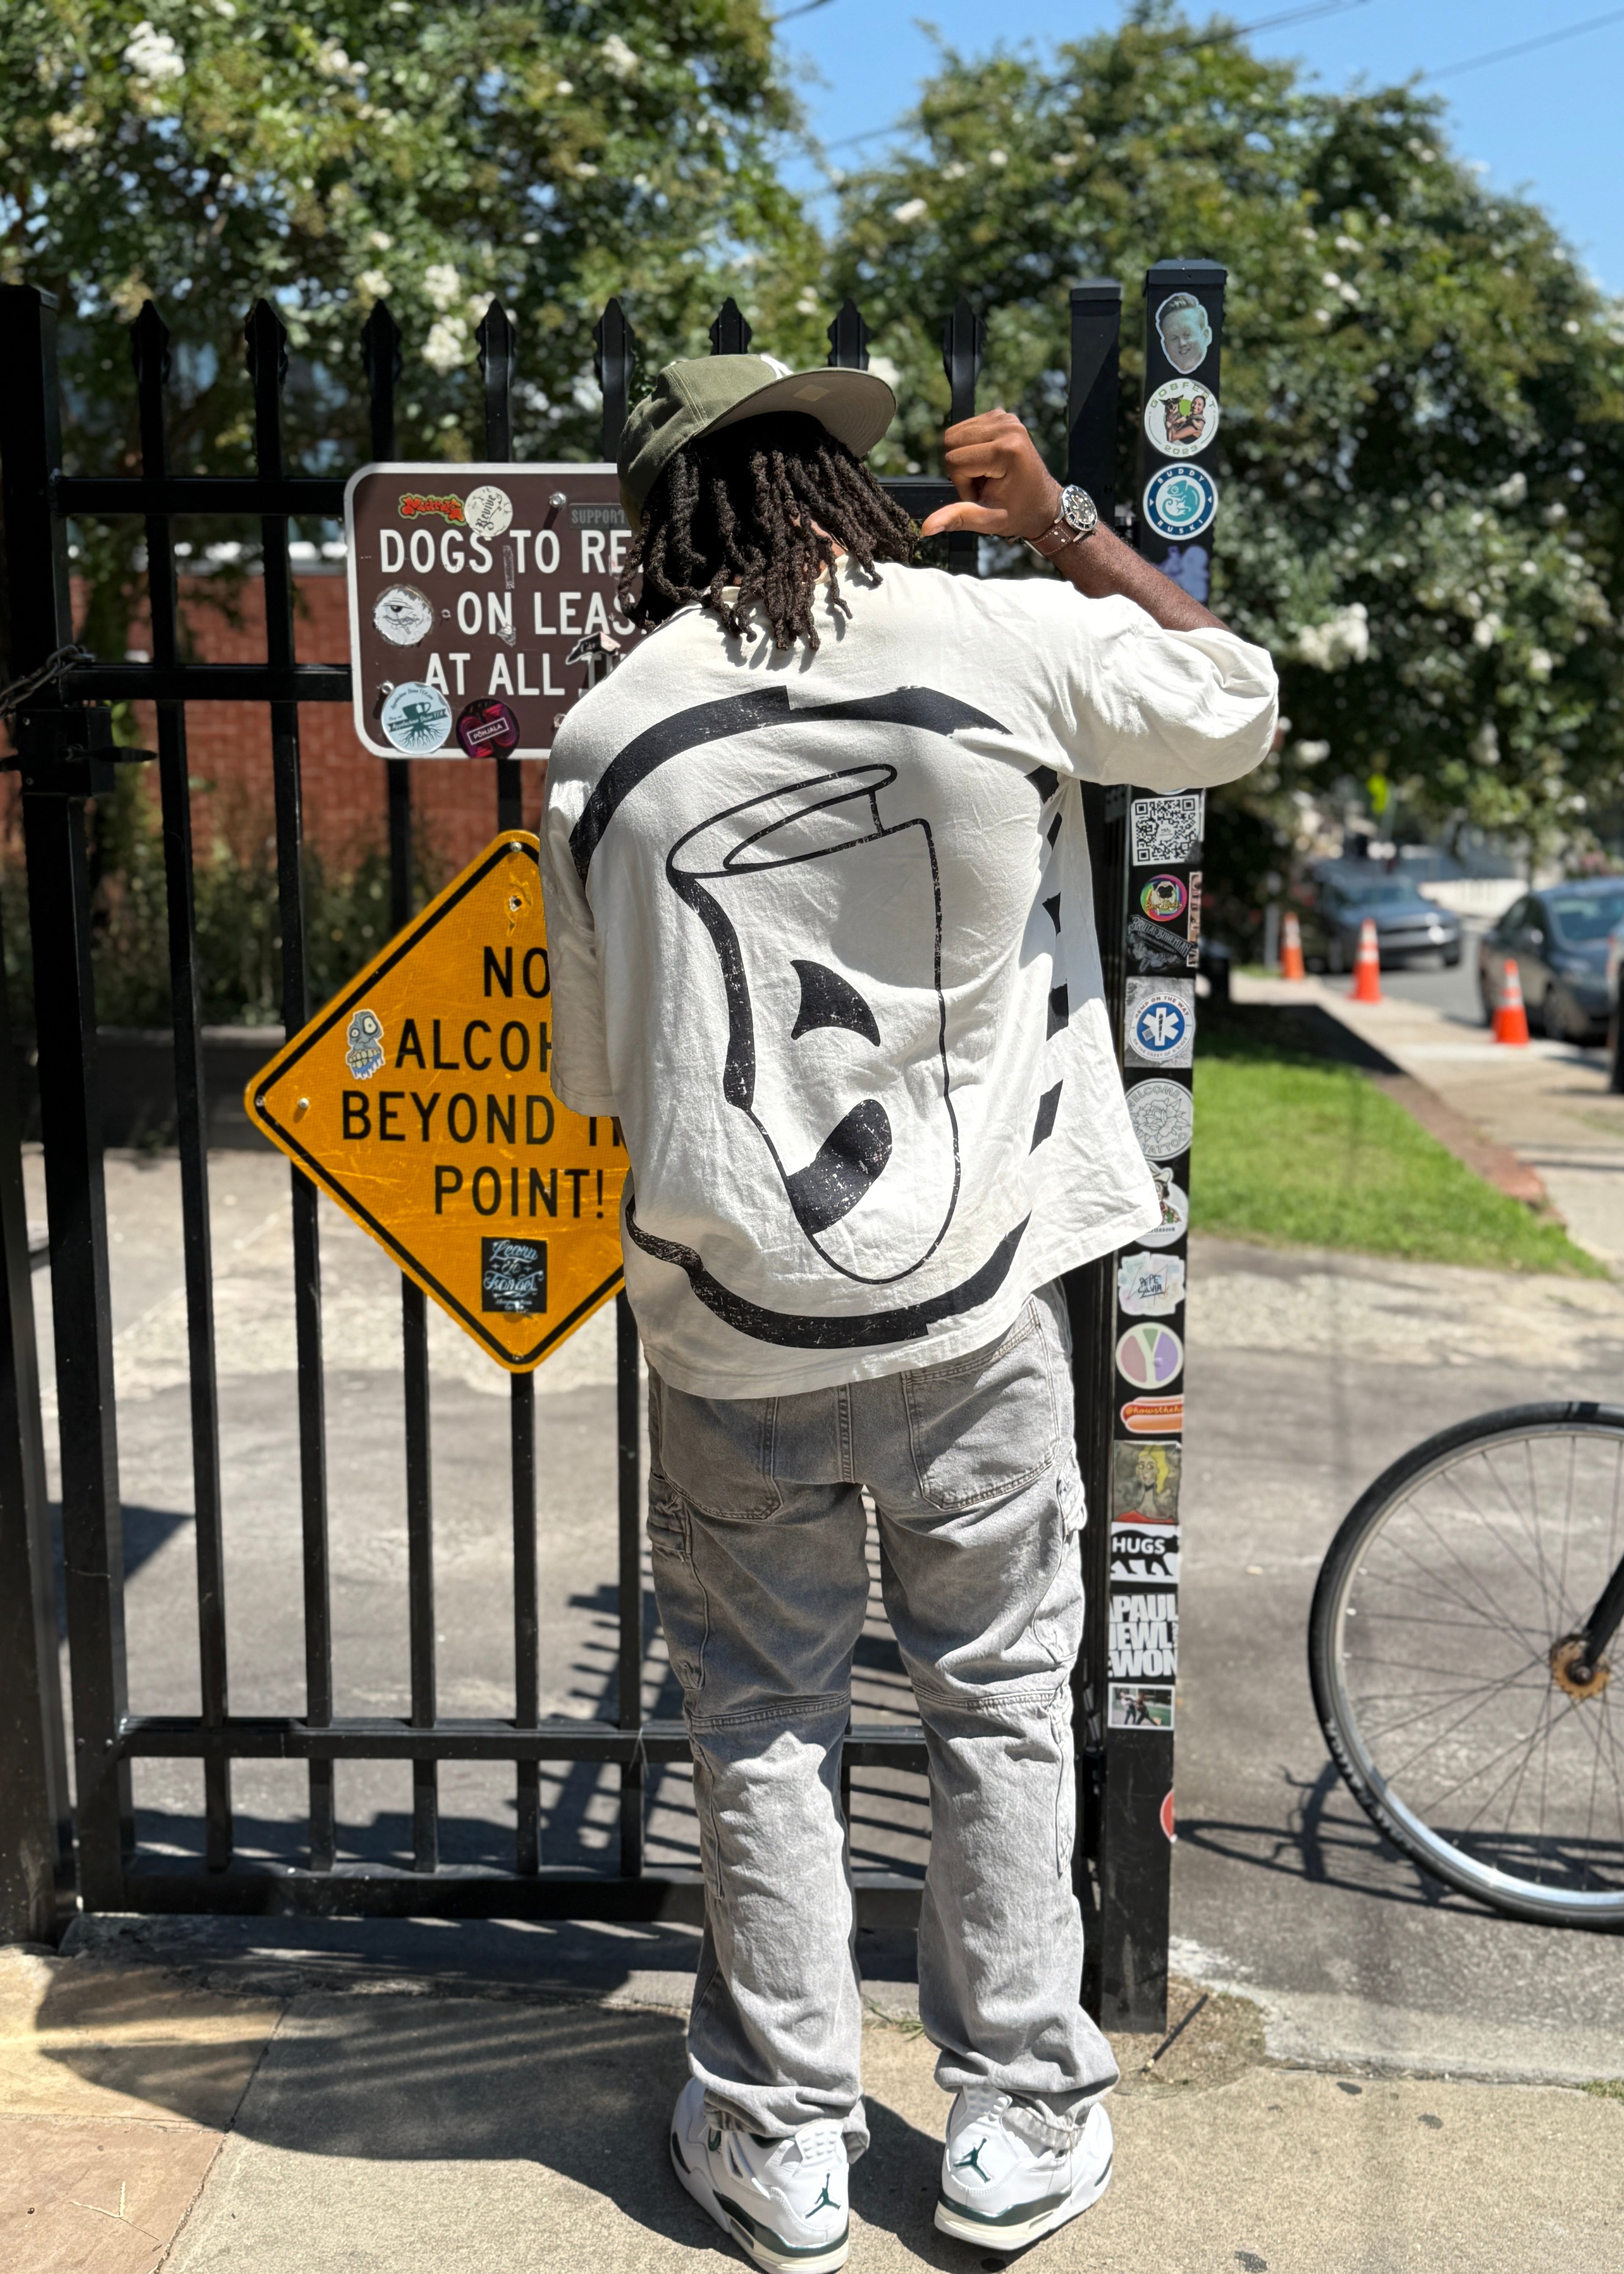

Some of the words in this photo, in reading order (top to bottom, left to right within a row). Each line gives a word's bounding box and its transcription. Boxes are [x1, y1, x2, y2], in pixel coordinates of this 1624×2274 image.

[1150, 382, 1215, 409] GOBFEST
[1157, 468, 1205, 484] BUDDY
[1157, 519, 1203, 534] RUSKI
[380, 529, 493, 573] DOGS
[510, 530, 560, 573] TO
[581, 530, 644, 573] RE
[457, 592, 512, 635] ON
[534, 592, 647, 635] LEAS
[425, 653, 471, 695] AT
[488, 653, 565, 695] ALL
[484, 946, 550, 999] NO
[1164, 995, 1177, 1004] THE
[1178, 1001, 1190, 1016] WAY
[343, 1090, 554, 1145] BEYOND
[1143, 1132, 1188, 1154] TATTOO
[435, 1164, 604, 1219] POINT!
[1112, 1537, 1166, 1554] HUGS
